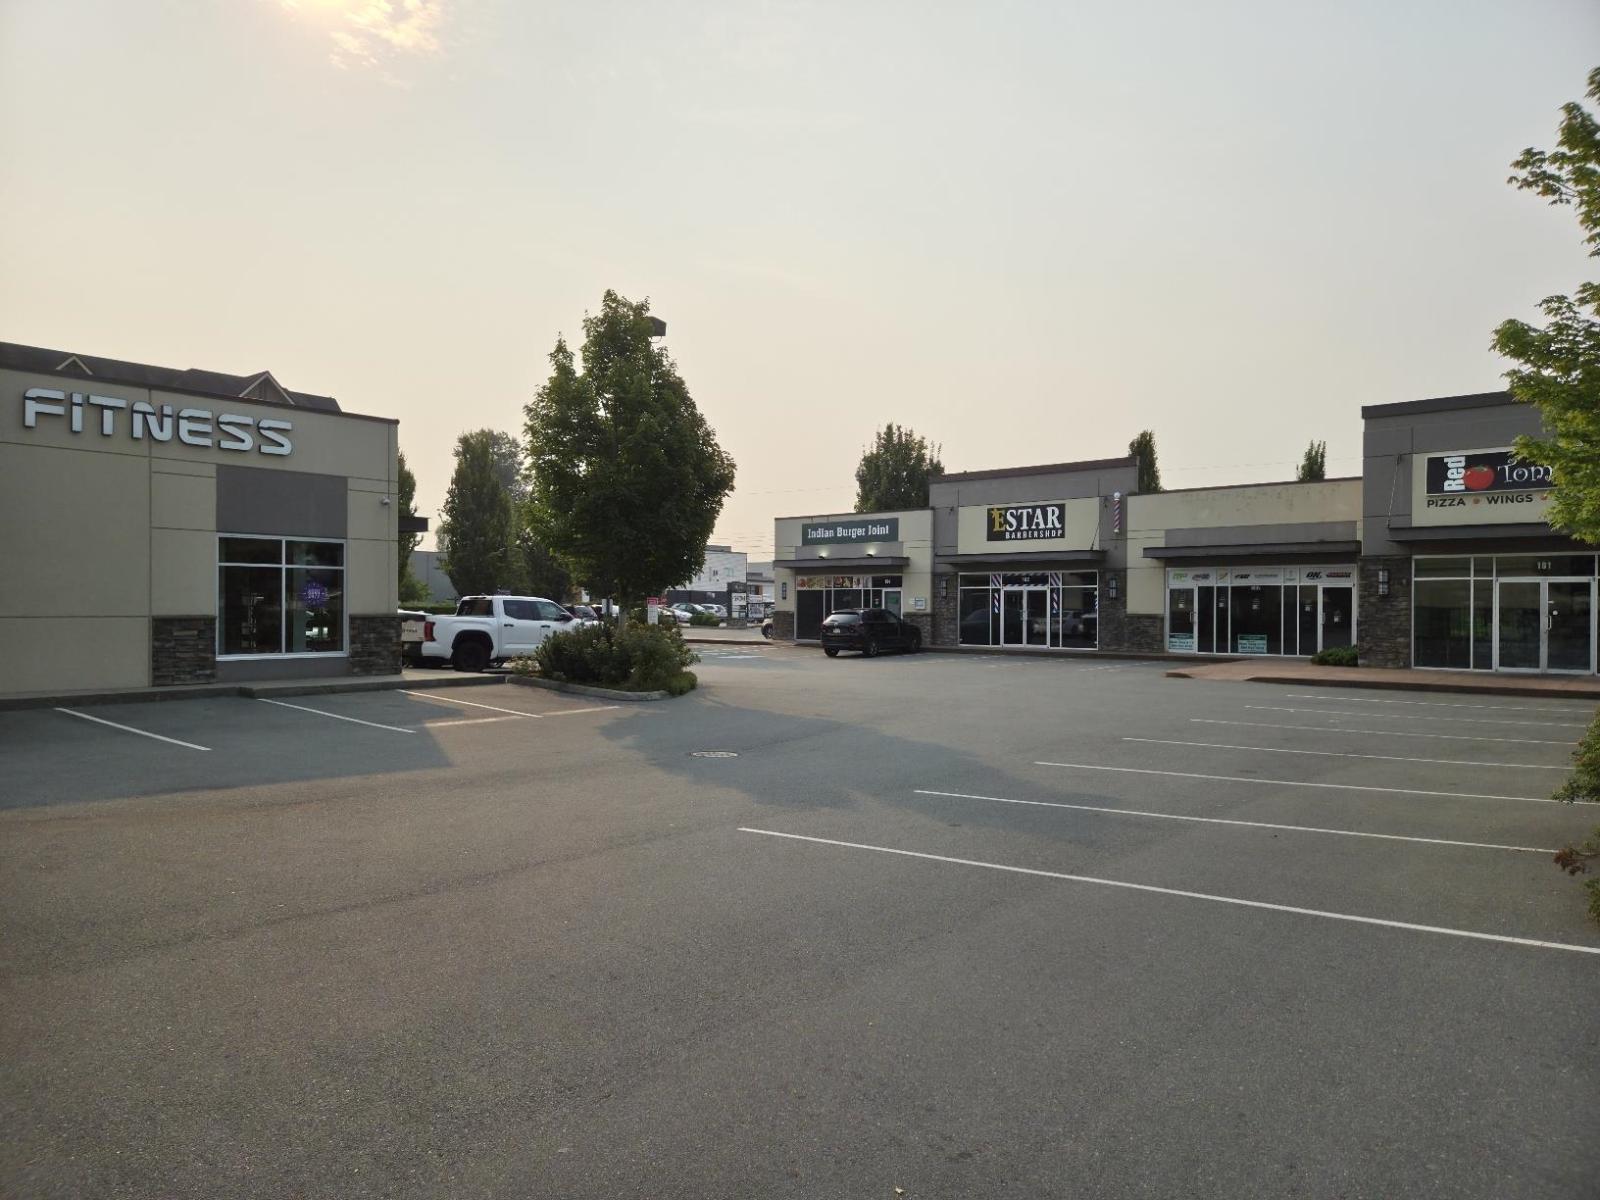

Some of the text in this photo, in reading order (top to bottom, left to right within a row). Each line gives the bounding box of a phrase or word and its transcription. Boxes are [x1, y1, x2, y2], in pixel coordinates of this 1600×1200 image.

[23, 387, 293, 457] FITNESS
[1443, 456, 1466, 492] Red
[1497, 459, 1553, 484] Tom
[1426, 493, 1534, 509] PIZZA WINGS
[807, 524, 889, 539] Indian Burger Joint
[1005, 529, 1063, 540] BARBERSHOP
